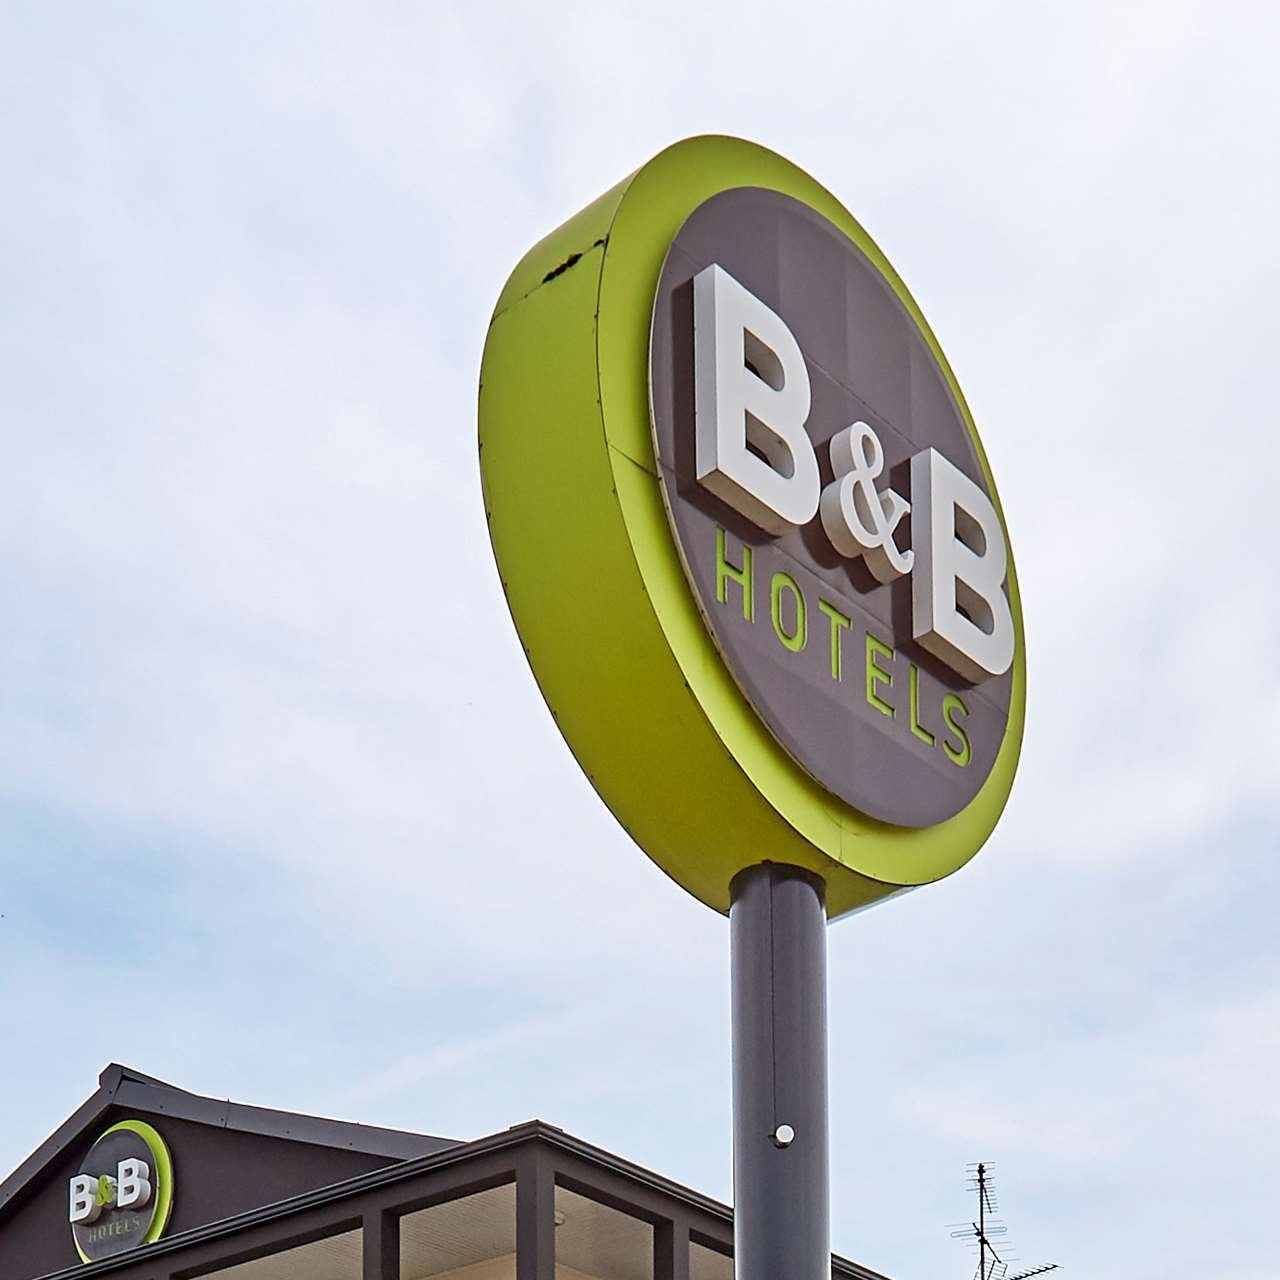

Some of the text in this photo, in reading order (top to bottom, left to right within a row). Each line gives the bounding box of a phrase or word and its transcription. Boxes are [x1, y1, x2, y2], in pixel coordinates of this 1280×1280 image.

[693, 262, 1016, 685] B&B
[715, 529, 973, 769] HOTELS
[70, 1158, 151, 1224] B&B
[88, 1215, 141, 1243] HOTELS
